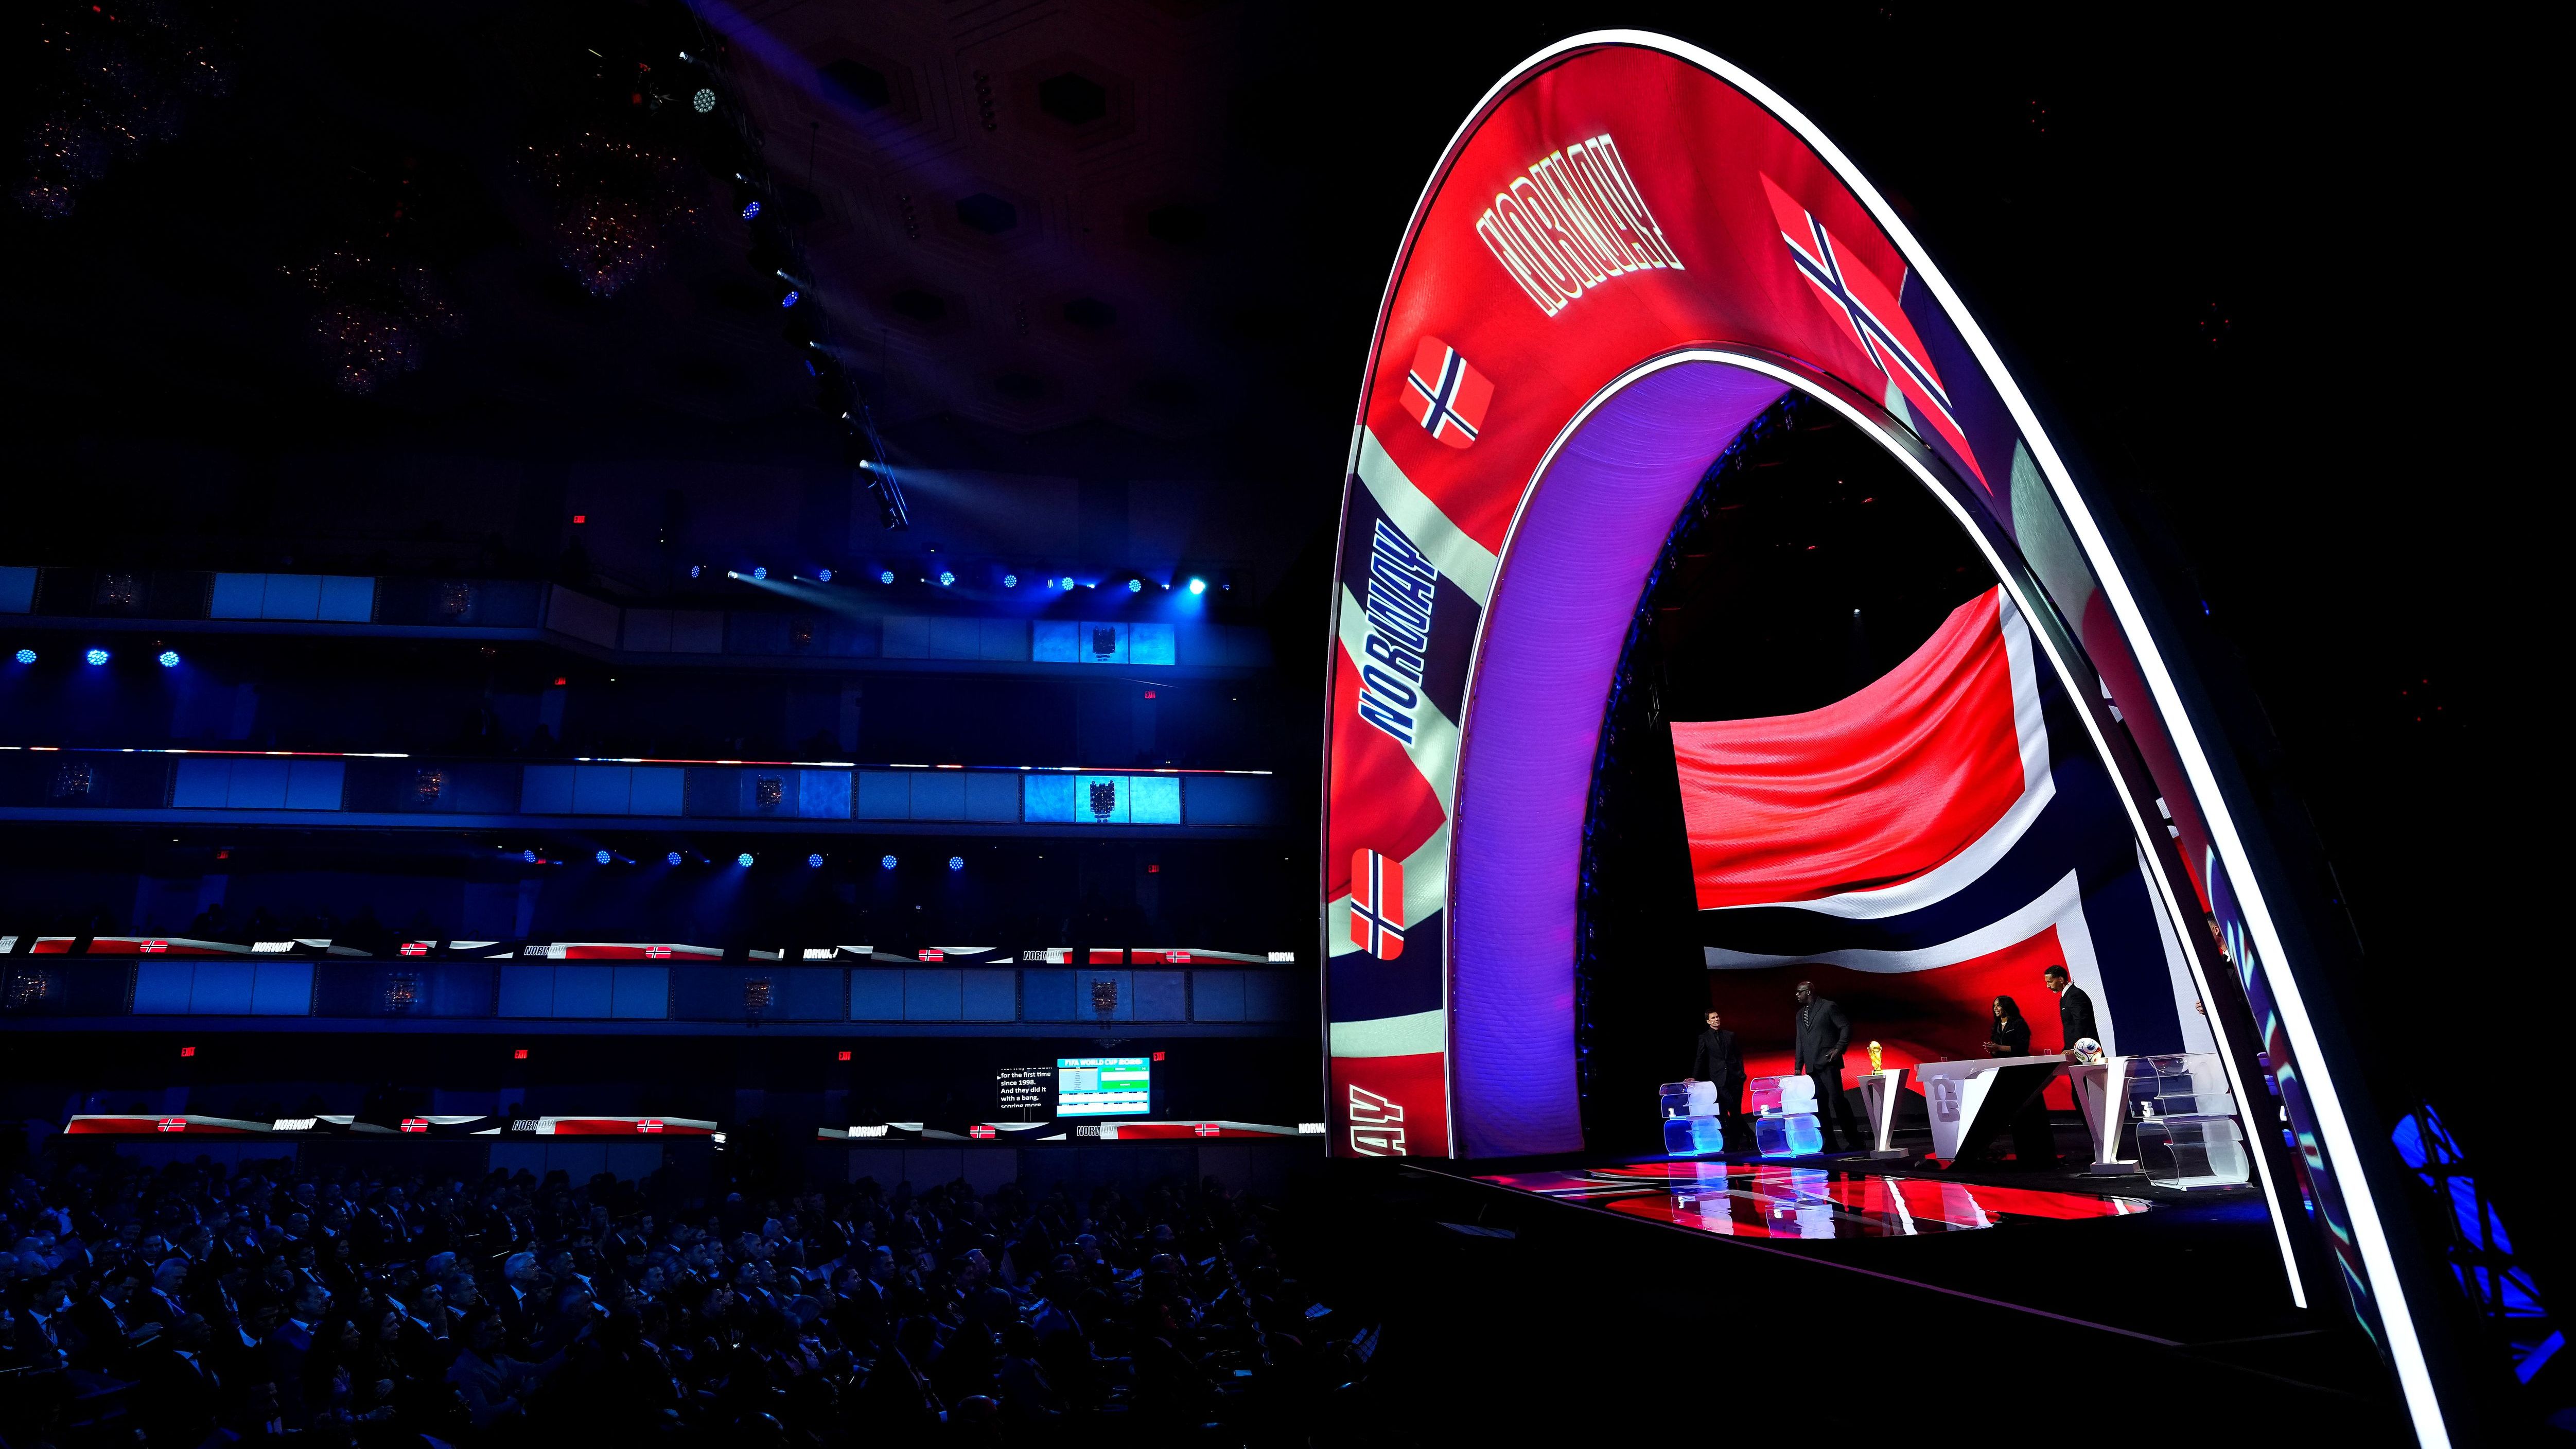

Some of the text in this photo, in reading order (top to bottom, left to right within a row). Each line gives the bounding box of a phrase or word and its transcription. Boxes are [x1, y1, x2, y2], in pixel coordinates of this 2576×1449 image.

[1475, 133, 1685, 318] NORWAY
[1357, 517, 1439, 749] NORWAY
[251, 941, 295, 952] NORWAY
[523, 945, 565, 956] NORWAY
[1023, 950, 1062, 961] NORWAY
[1268, 952, 1294, 962] NORW
[2141, 1101, 2154, 1118] 3
[272, 1118, 318, 1130] NORWAY
[512, 1119, 555, 1131] NORWAY
[1298, 1123, 1325, 1134] NORW
[848, 1125, 888, 1137] NORWAY
[1076, 1124, 1115, 1137] NORWAY
